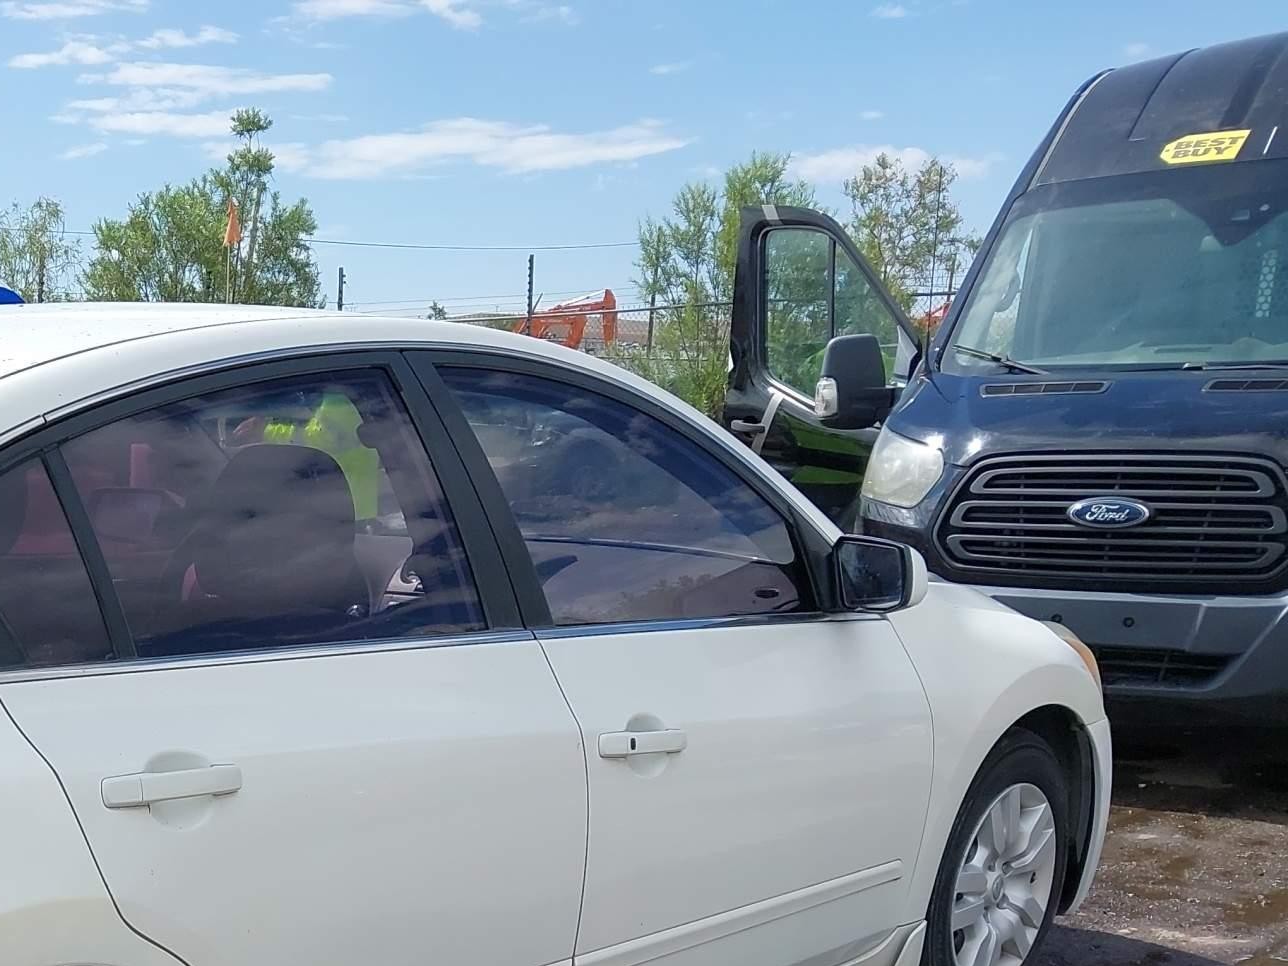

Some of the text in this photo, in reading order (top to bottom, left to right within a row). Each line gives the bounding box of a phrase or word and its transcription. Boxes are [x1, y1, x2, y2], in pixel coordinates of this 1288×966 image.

[1174, 136, 1246, 150] BEST
[1171, 146, 1233, 159] BUY
[1085, 504, 1130, 521] Ford
